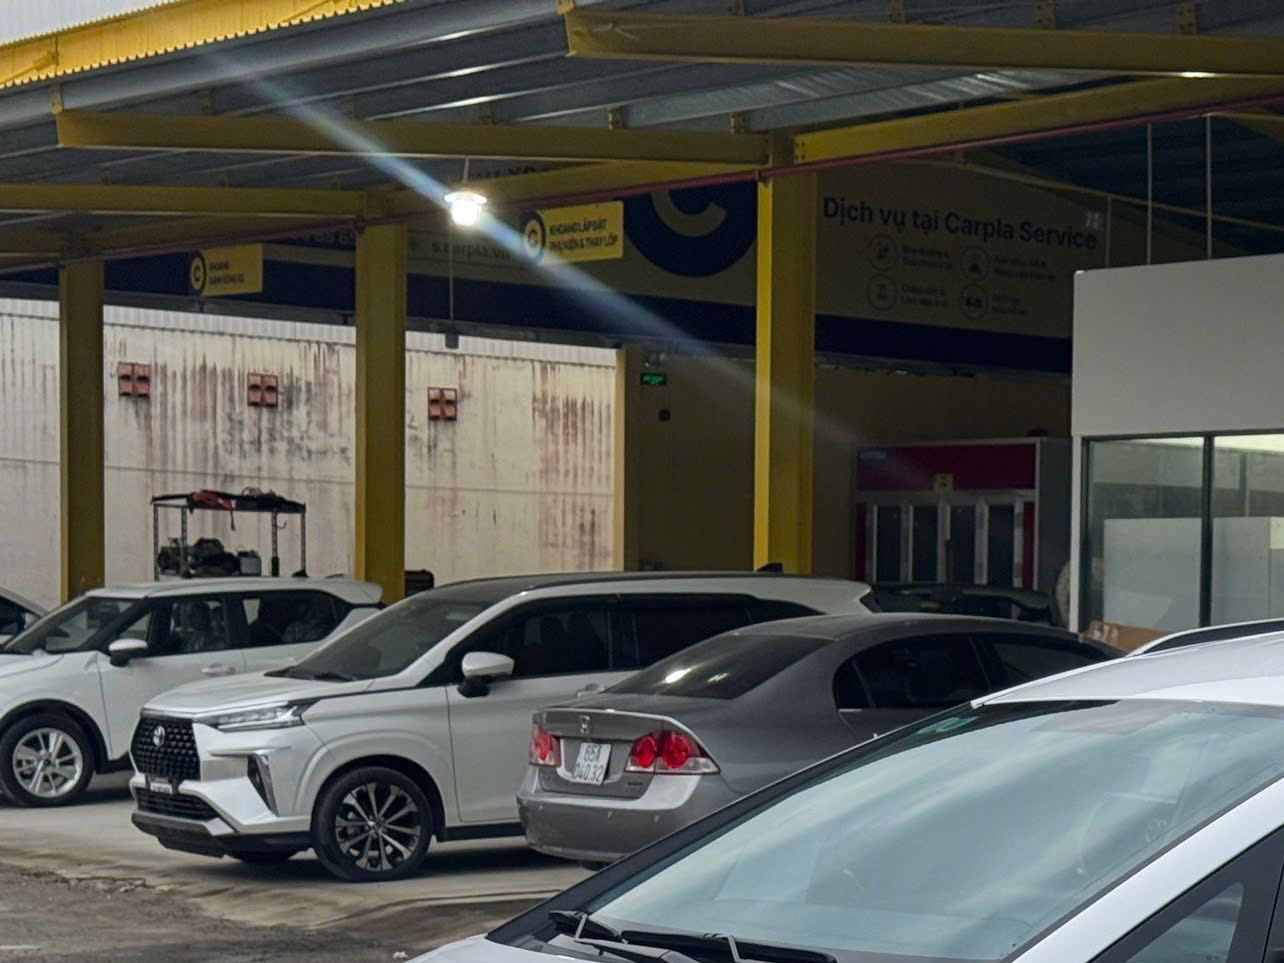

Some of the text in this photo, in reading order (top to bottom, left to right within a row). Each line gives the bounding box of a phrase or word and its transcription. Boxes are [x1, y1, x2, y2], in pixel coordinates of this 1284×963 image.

[823, 196, 1098, 249] Dịch vụ tại Carpla Service
